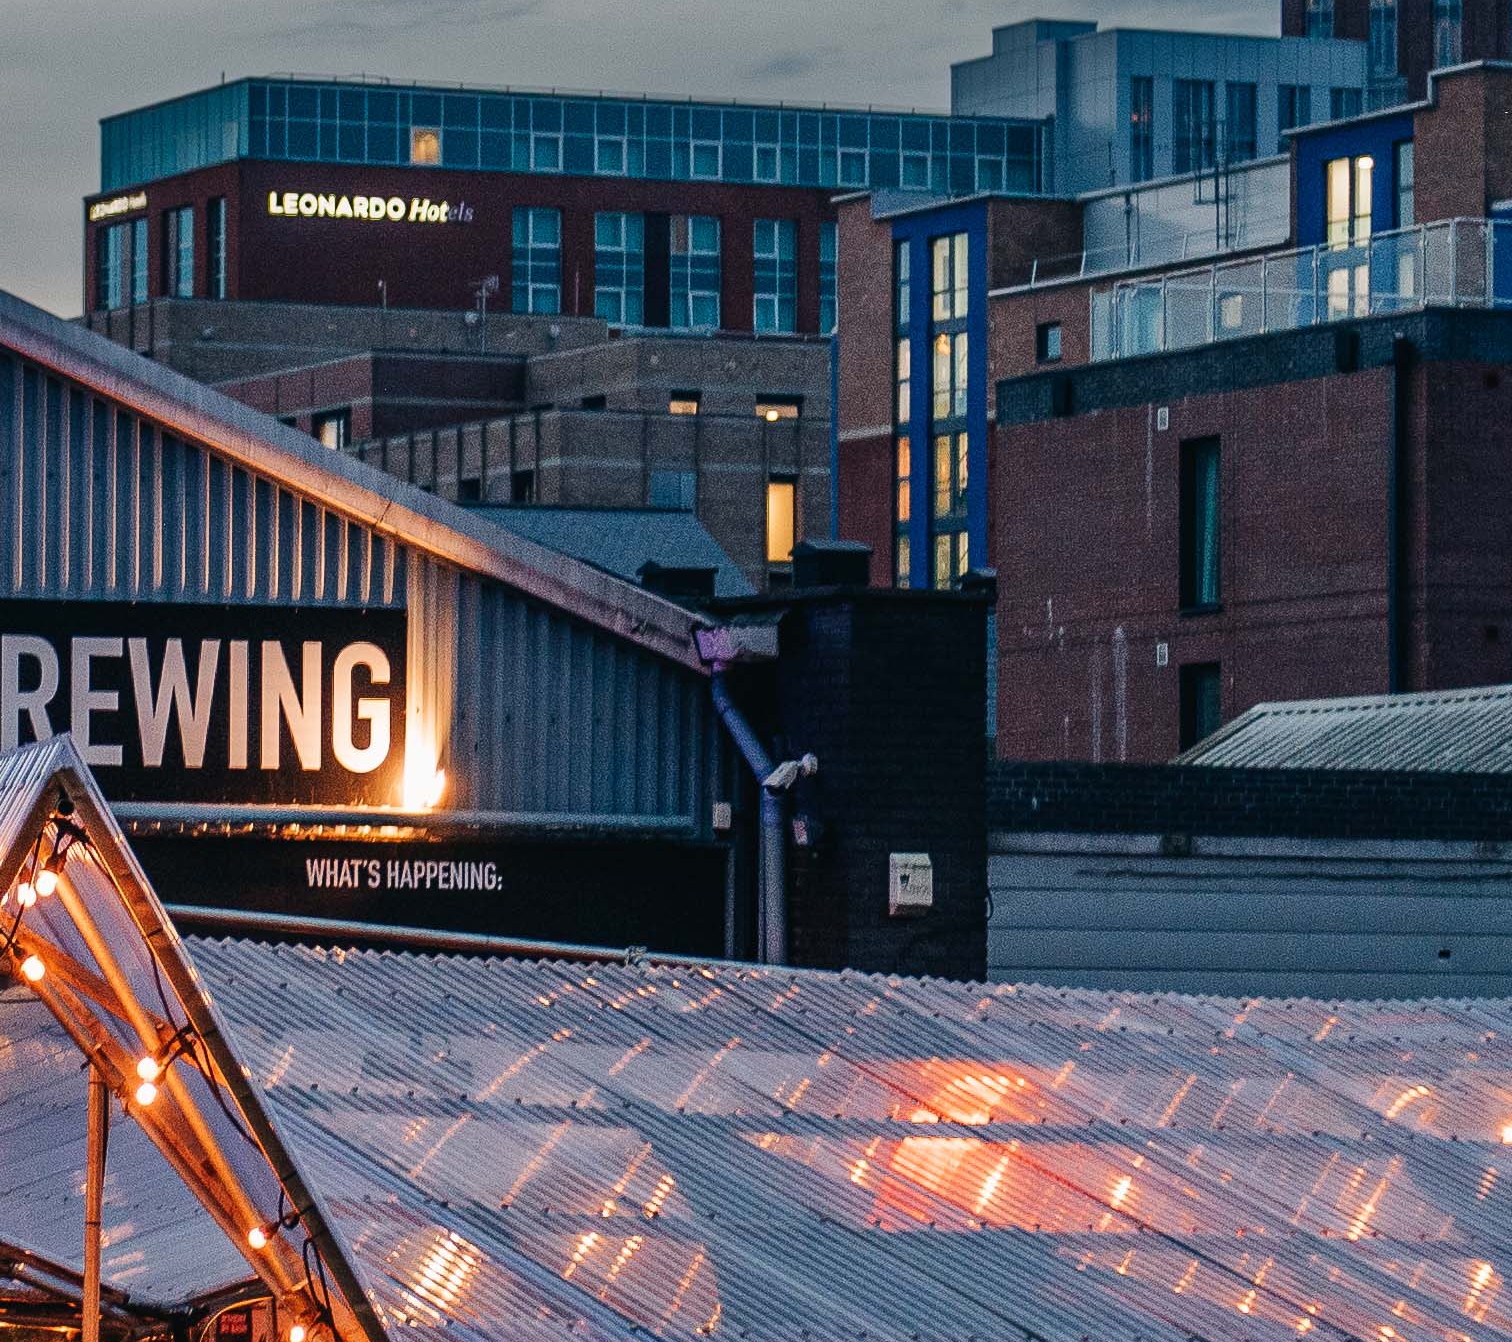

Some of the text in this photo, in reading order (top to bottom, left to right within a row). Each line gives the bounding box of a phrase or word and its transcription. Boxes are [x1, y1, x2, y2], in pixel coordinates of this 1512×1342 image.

[268, 191, 474, 223] LEONARDO Hotels
[306, 858, 381, 888] WHAT'S
